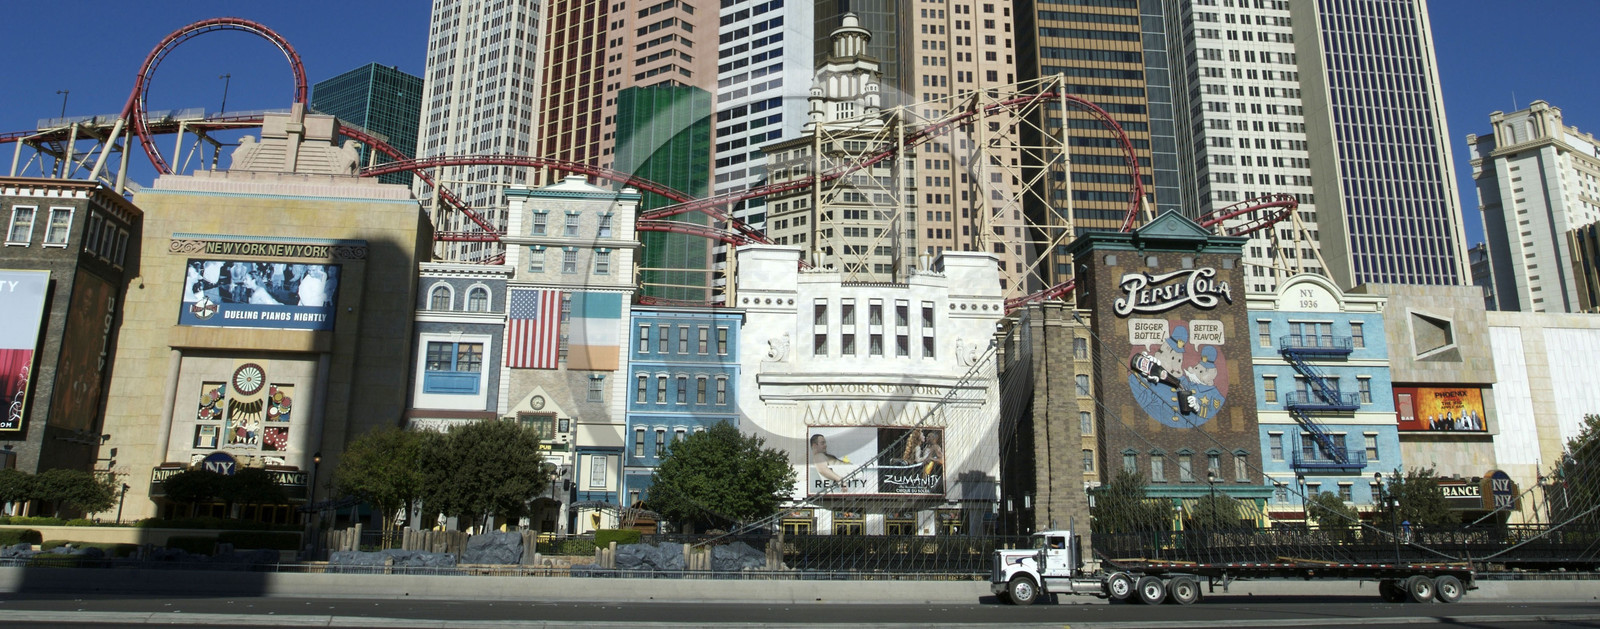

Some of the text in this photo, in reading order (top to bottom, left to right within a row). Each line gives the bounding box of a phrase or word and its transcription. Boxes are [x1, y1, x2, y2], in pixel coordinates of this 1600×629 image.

[1300, 289, 1314, 298] NY
[1300, 300, 1318, 309] 1936
[224, 310, 259, 320] DUELING
[261, 312, 292, 321] PIANOS
[293, 313, 327, 322] NIGHTLY
[1134, 322, 1163, 331] BIGGER
[1134, 330, 1166, 342] BOTTLE!
[1193, 331, 1223, 343] FLAVOR!
[806, 384, 942, 396] NEW YORK NEW YORK
[1434, 390, 1468, 399] PHOENIX
[815, 479, 868, 488] REALITY
[884, 474, 941, 488] ZUMANITY
[1492, 478, 1510, 491] NY
[1443, 486, 1480, 496] RANCE
[1494, 494, 1513, 507] NY
